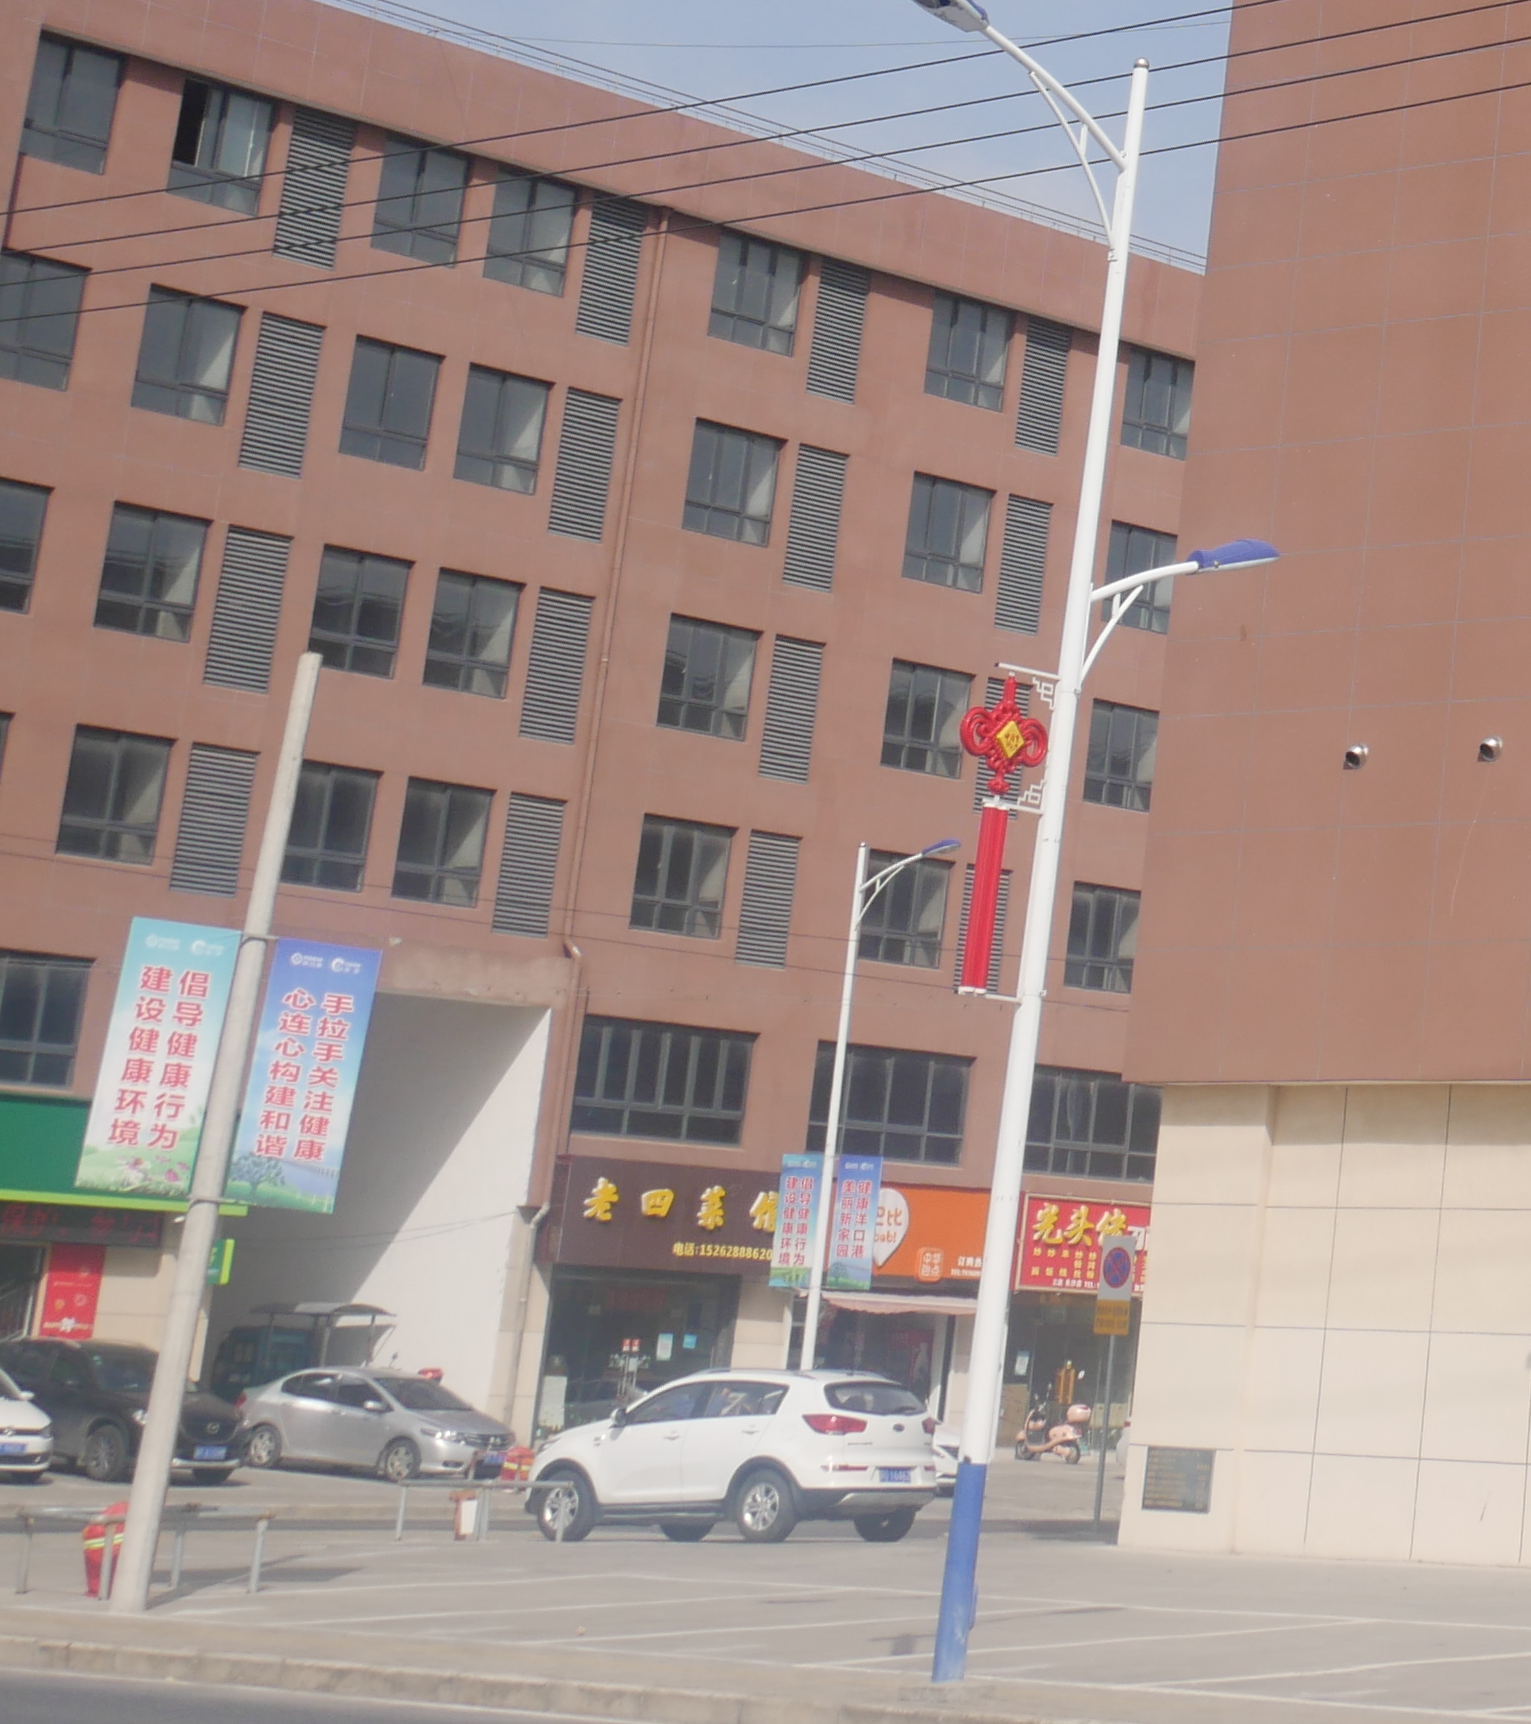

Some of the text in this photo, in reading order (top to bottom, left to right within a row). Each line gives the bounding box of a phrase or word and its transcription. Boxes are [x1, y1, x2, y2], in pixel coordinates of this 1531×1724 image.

[108, 965, 172, 1147] 建设健康环境
[147, 970, 210, 1150] 倡导健康行为
[255, 988, 315, 1158] 心连心构建和谐
[293, 992, 354, 1162] 手拉手关注健康
[778, 1177, 799, 1265] 建设健康环境
[794, 1178, 814, 1265] 倡导健康行为
[835, 1179, 856, 1257] 美丽新家园
[852, 1180, 872, 1258] 健康洋口港
